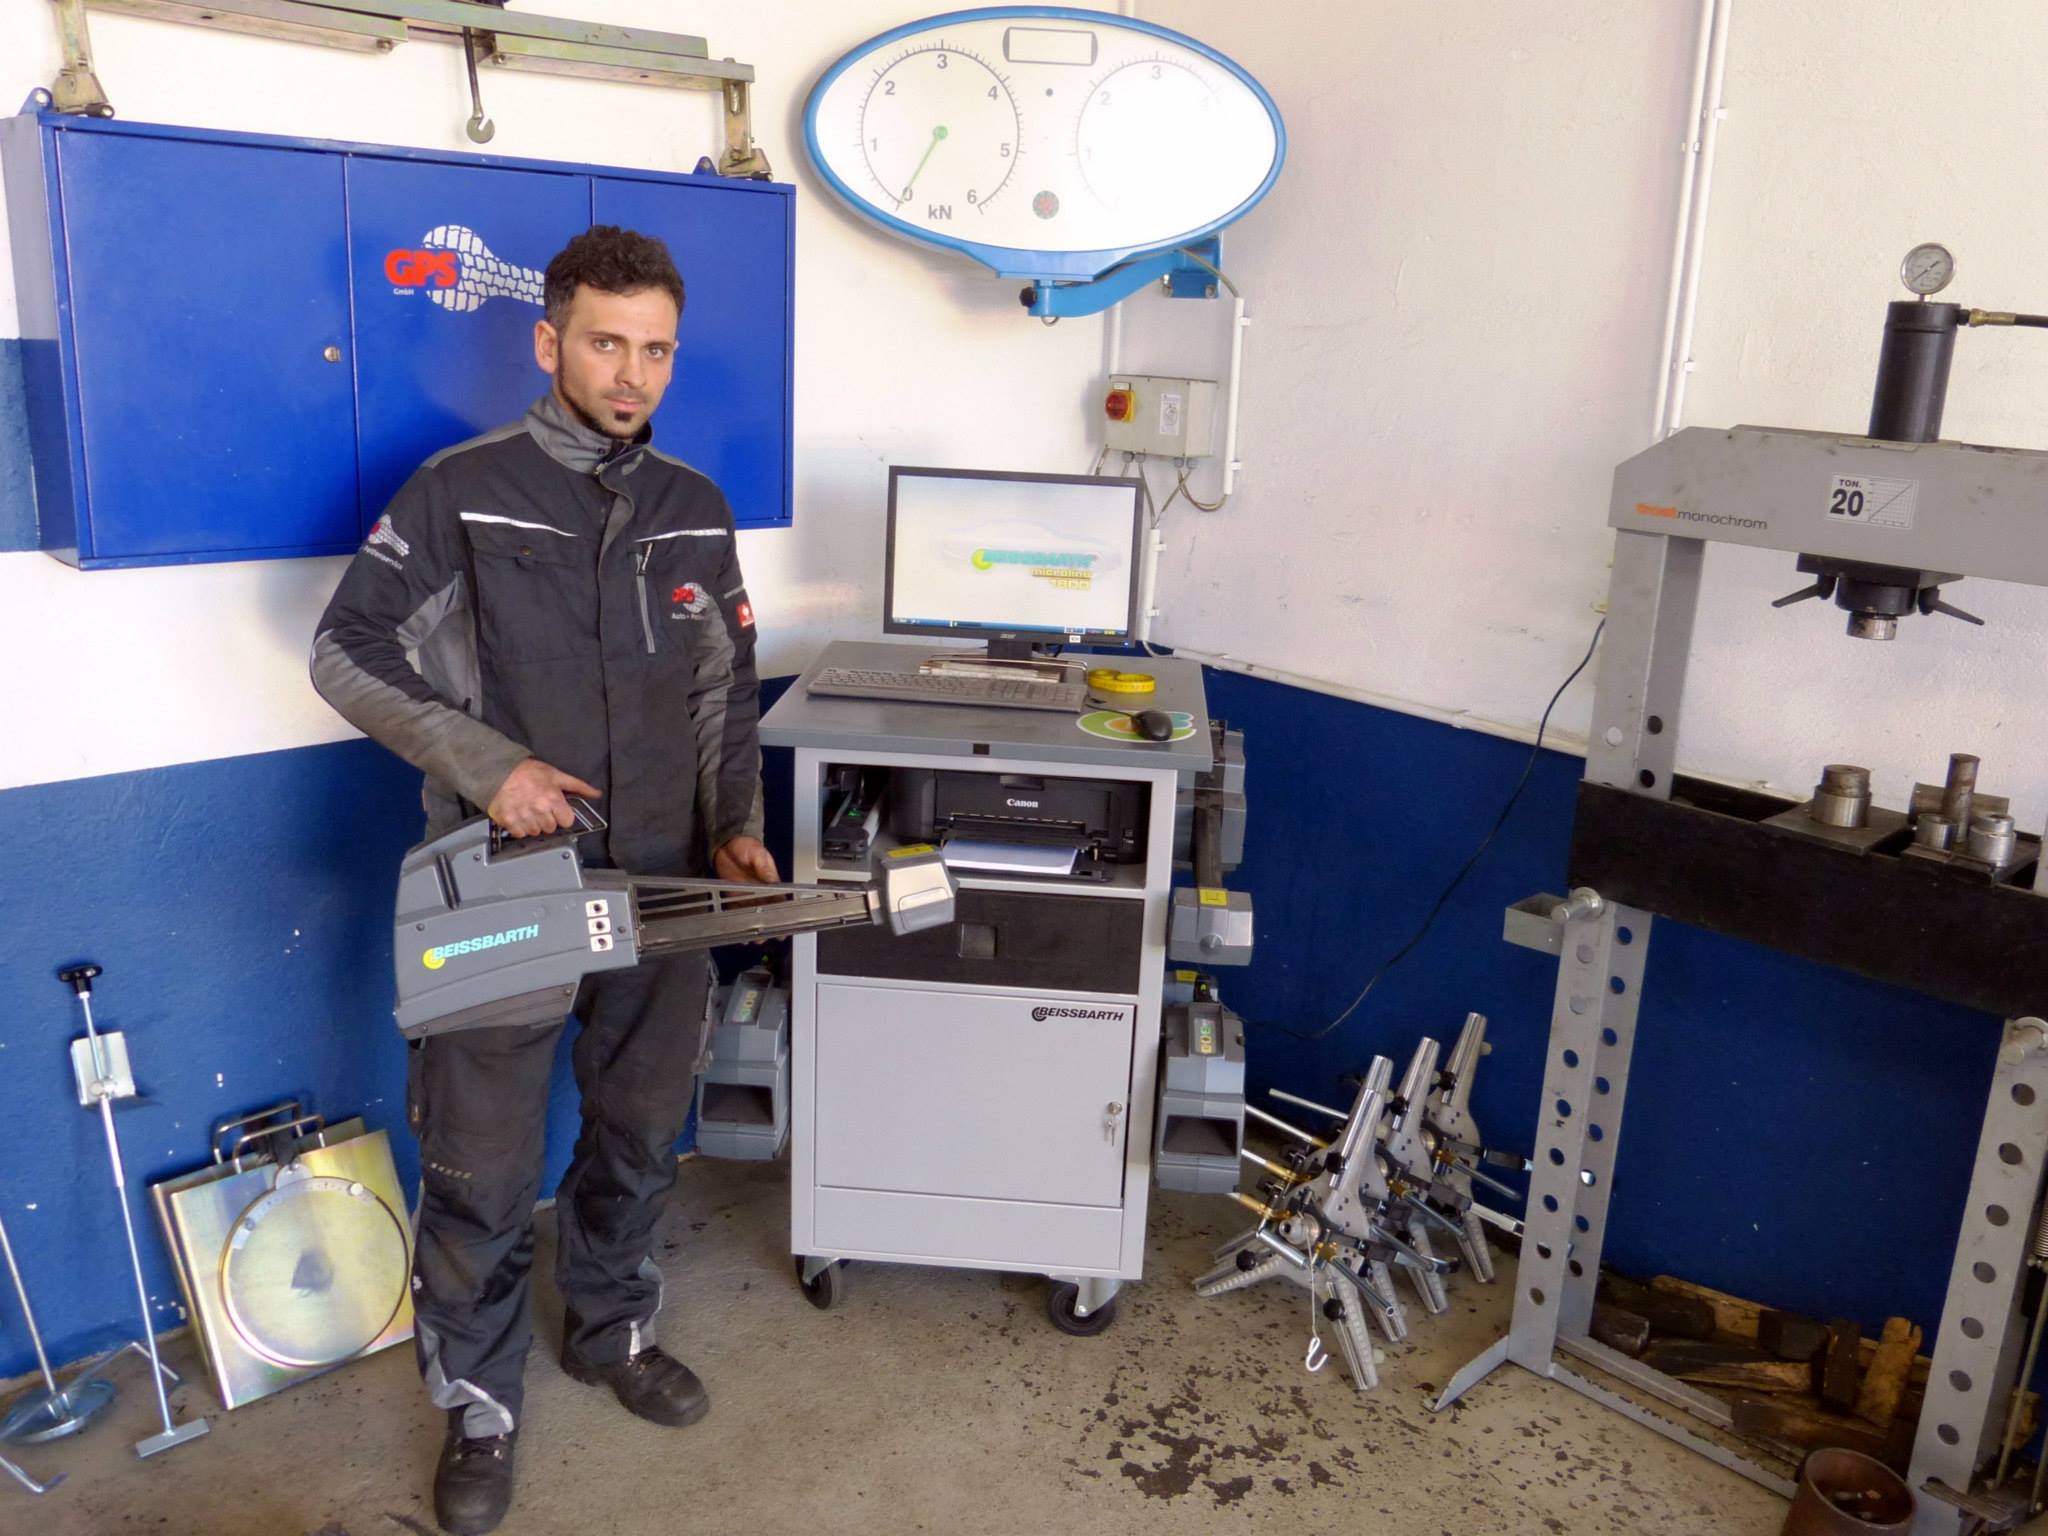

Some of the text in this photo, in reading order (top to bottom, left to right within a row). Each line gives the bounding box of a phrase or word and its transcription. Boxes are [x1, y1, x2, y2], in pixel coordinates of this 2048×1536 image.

[935, 53, 949, 70] 3
[1151, 65, 1163, 81] 3
[884, 80, 896, 96] 2
[987, 86, 999, 101] 4
[870, 138, 878, 152] 1
[999, 143, 1011, 158] 5
[902, 187, 913, 203] 0
[966, 189, 978, 205] 6
[927, 204, 952, 221] kN
[384, 250, 458, 287] GPS
[1830, 488, 1864, 517] 20
[1677, 510, 1768, 530] monochrom
[1006, 798, 1039, 808] Canon
[432, 924, 539, 960] BEISSBARTH
[1039, 1006, 1124, 1022] BEISSBARTH
